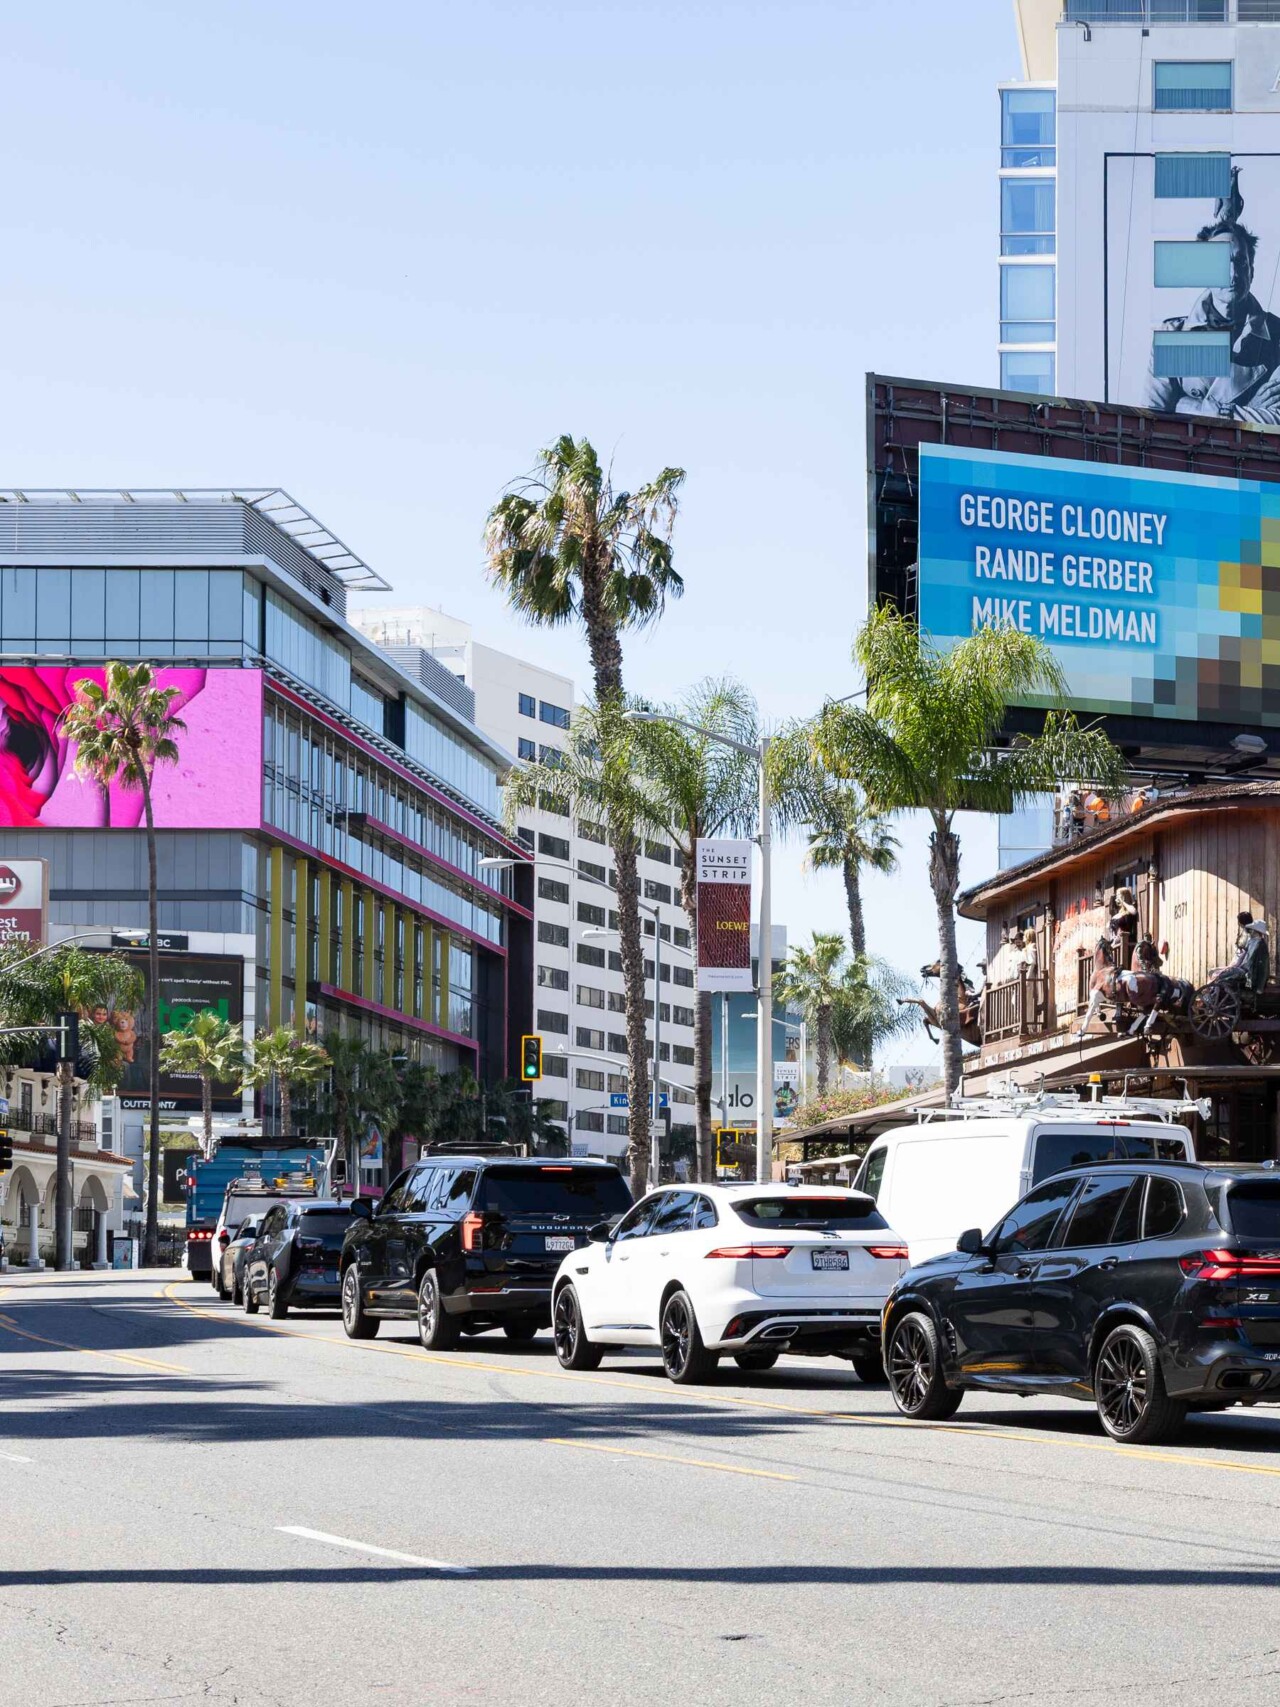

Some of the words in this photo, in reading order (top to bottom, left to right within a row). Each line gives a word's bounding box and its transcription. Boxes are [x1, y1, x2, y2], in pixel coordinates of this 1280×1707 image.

[960, 493, 1054, 534] GEORGE
[1061, 504, 1167, 545] CLOONEY
[975, 545, 1054, 585] RANDE
[1062, 554, 1153, 594] GERBER
[972, 596, 1032, 633] MIKE
[1040, 602, 1156, 644] MELDMAN
[702, 855, 747, 864] SUNSET
[702, 870, 747, 879] STRIP
[0, 916, 18, 929] est
[716, 921, 749, 931] LOEWE
[815, 1257, 847, 1268] 9THR586
[1246, 1293, 1270, 1301] X5
